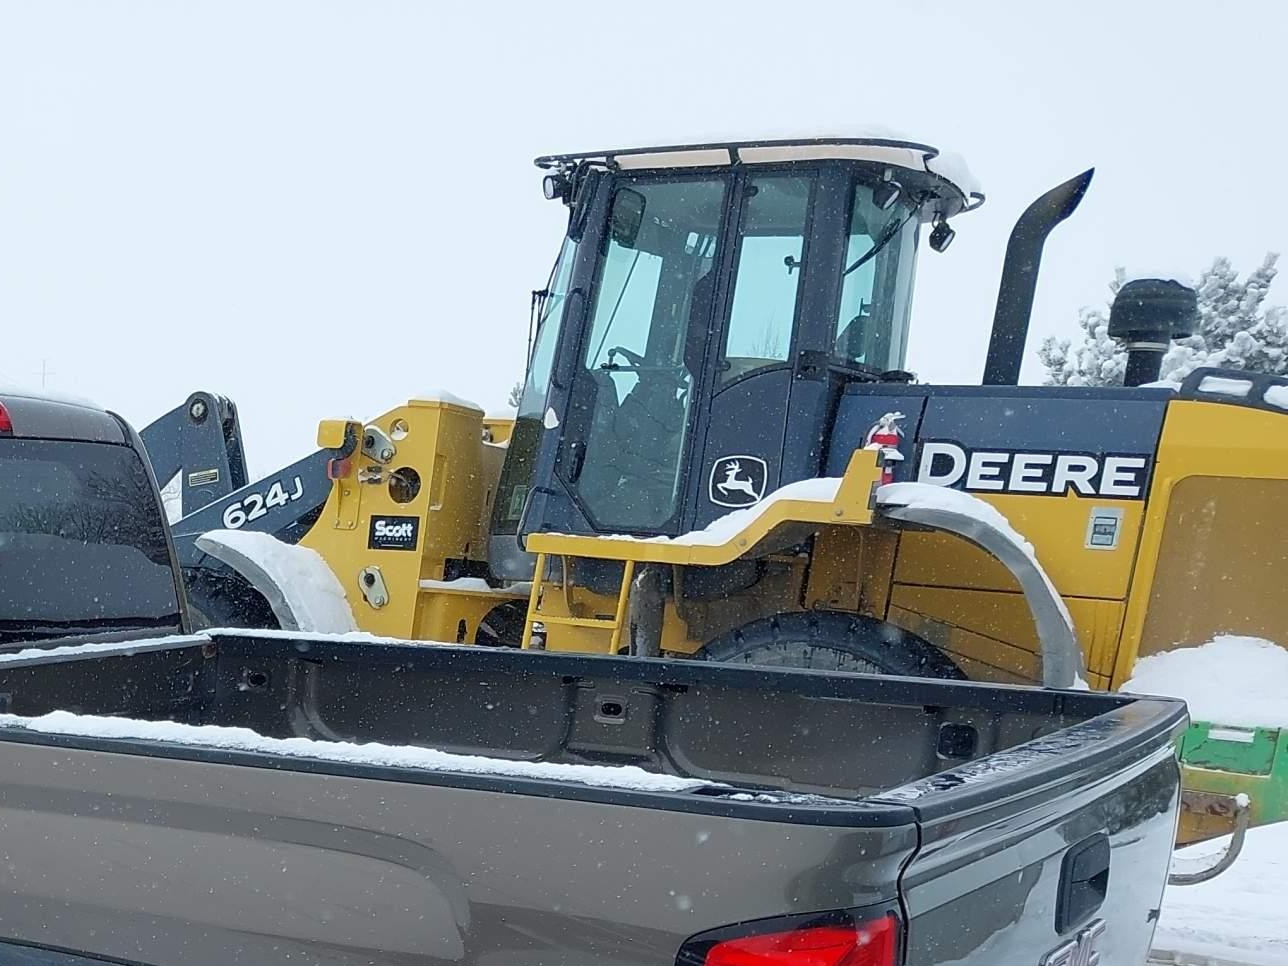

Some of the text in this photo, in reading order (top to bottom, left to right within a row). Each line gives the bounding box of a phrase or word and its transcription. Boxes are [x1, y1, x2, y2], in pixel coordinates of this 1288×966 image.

[918, 442, 1146, 497] DEERE
[223, 476, 304, 529] 624J
[374, 520, 414, 537] Scott
